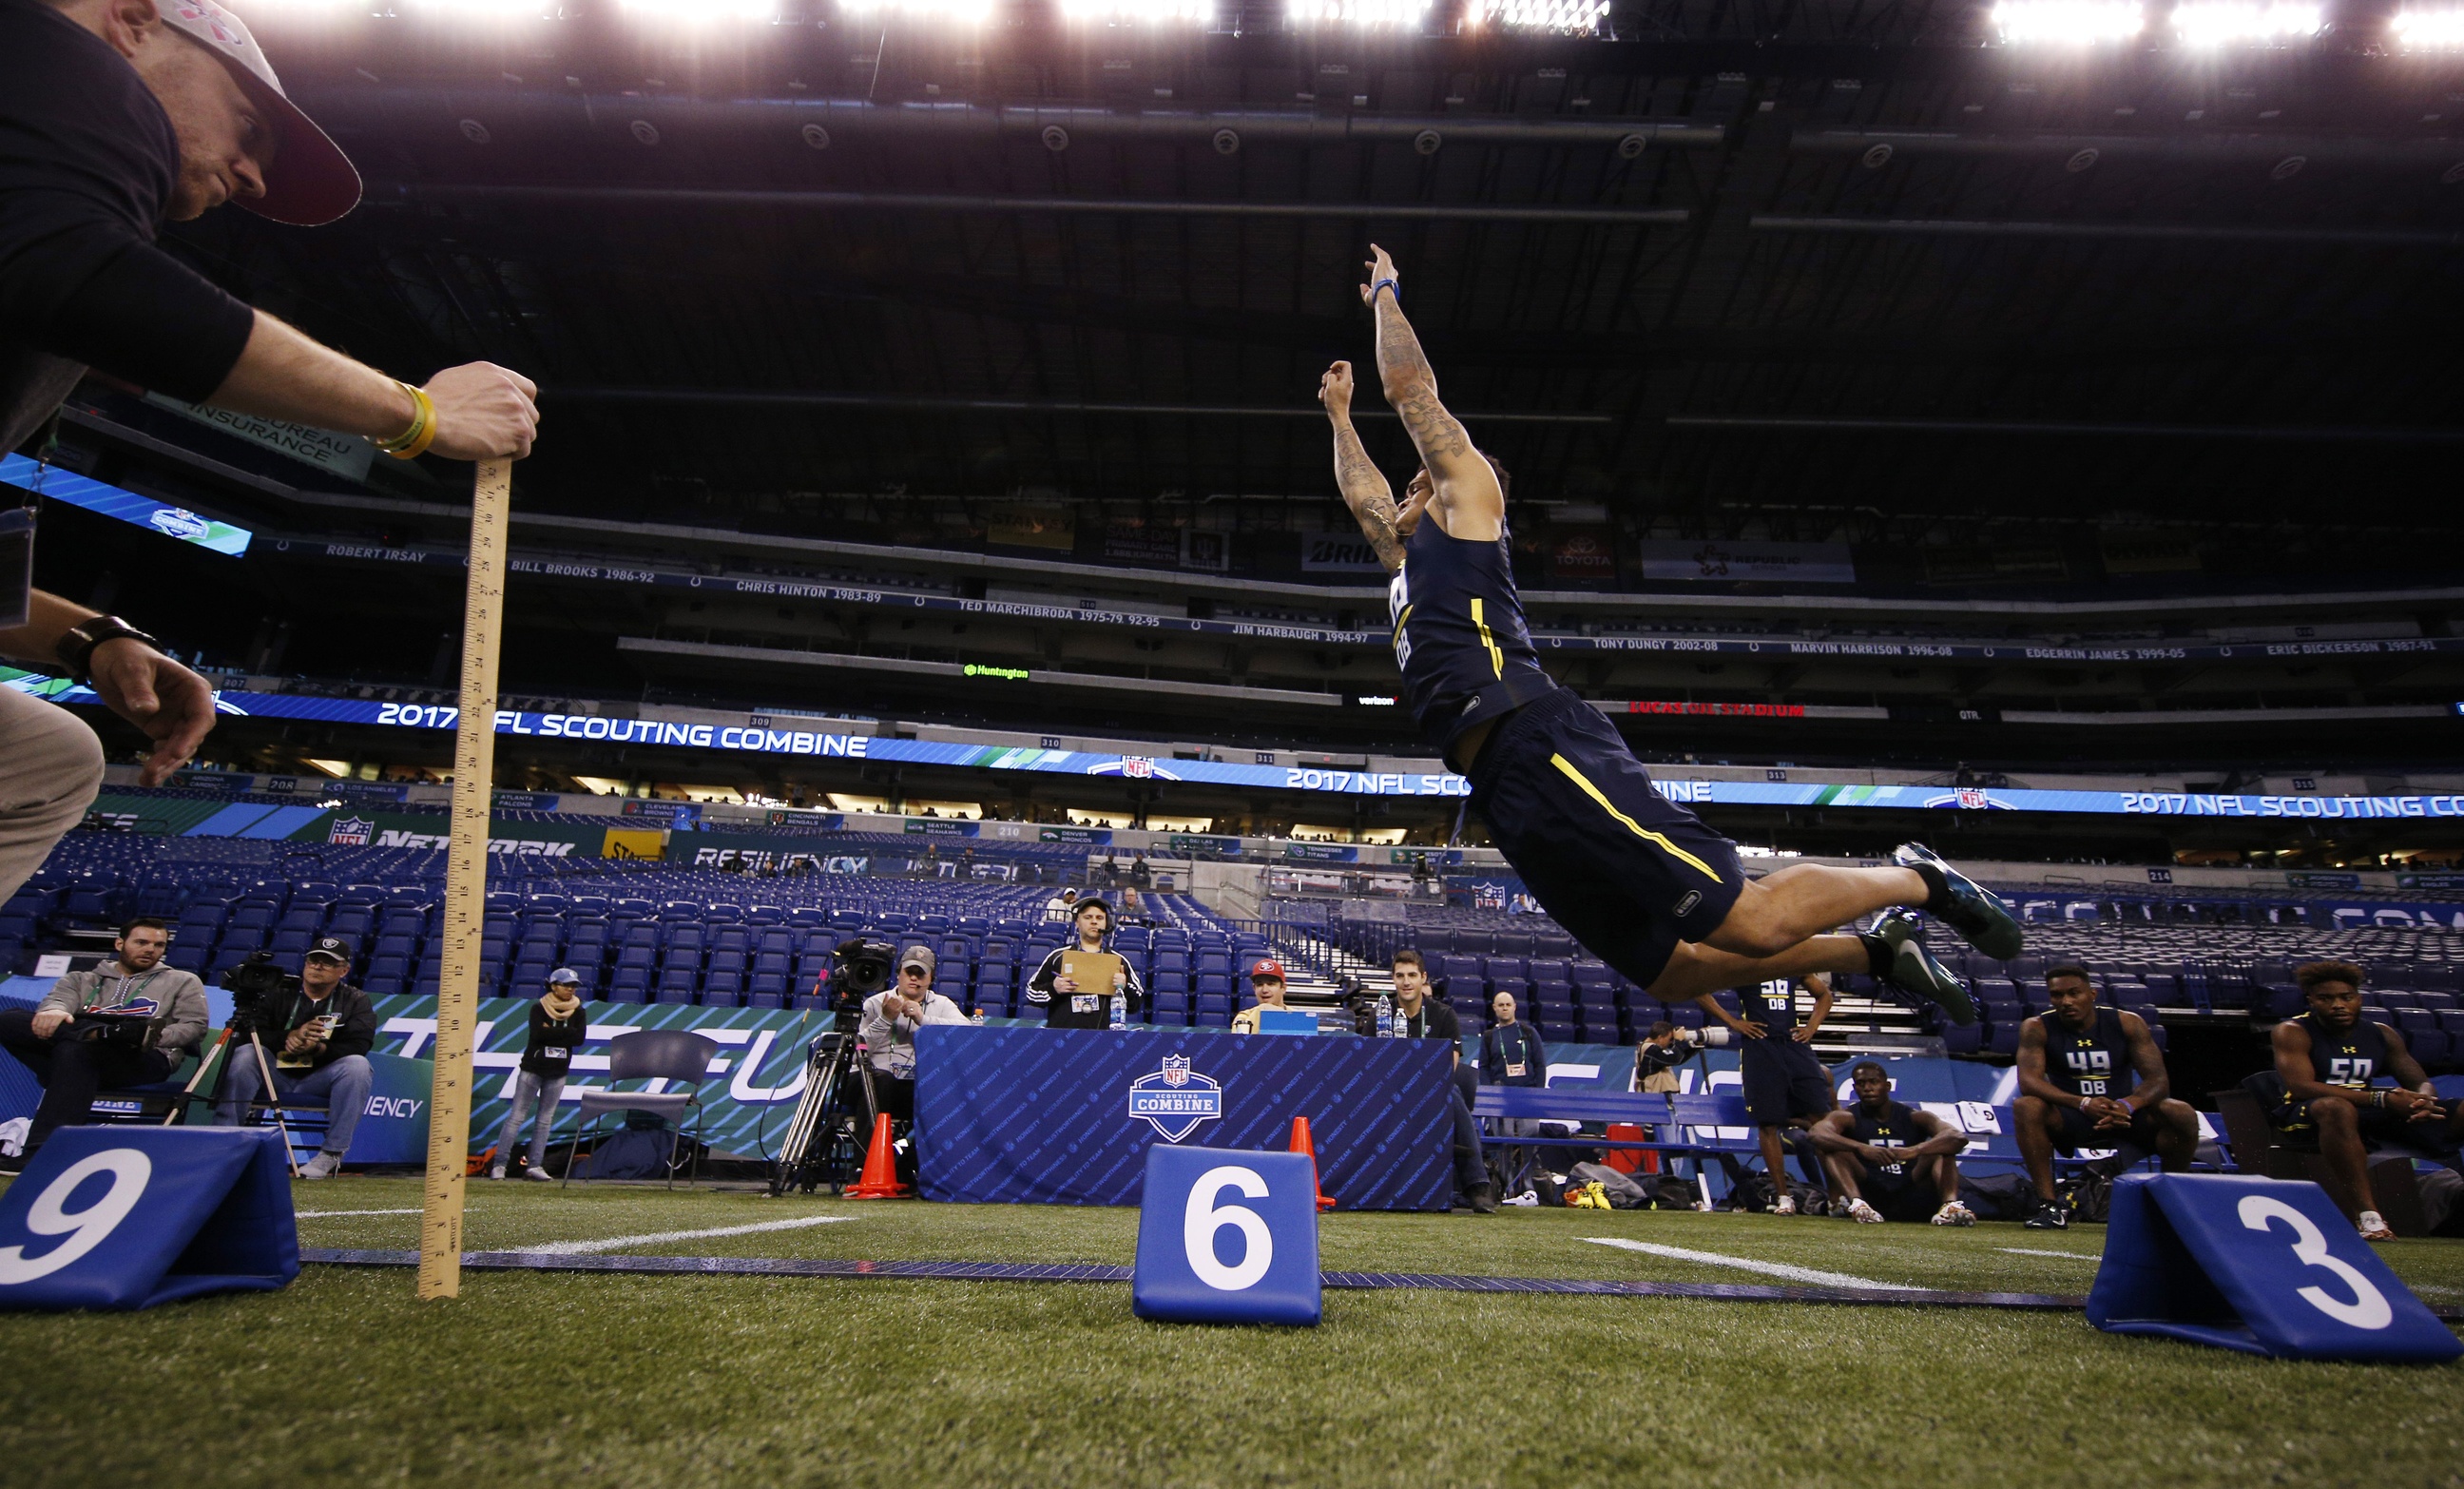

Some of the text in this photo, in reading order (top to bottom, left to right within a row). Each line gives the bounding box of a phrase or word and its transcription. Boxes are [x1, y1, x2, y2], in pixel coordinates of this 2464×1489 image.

[189, 406, 333, 462] INSURANCE
[489, 467, 496, 478] 32
[487, 491, 494, 501] 31
[155, 515, 204, 535] COMBINE
[485, 513, 493, 526] 30
[484, 536, 491, 549] 29
[326, 544, 427, 563] ROBERT IRSAY
[1735, 555, 1801, 566] REPUBLIC
[482, 561, 490, 571] 28
[1554, 555, 1611, 567] TOYOTA
[511, 560, 656, 585] BILL BROOKS 1986-92
[480, 584, 488, 596] 27
[736, 580, 882, 604] CHRIS HINTON 1983-89
[478, 609, 487, 619] 26
[959, 600, 983, 612] TED
[985, 603, 1073, 620] MARCHIBRODA
[1128, 614, 1161, 628] 92-95
[477, 632, 485, 644] 25
[1232, 624, 1369, 644] JIM HARBAUGH 1994-97
[1593, 638, 1719, 652] TONY DUNGY 2002-08
[1791, 642, 1954, 657] MARVIN HARRISON 1996-08
[2267, 644, 2295, 656] ERIC
[2297, 642, 2380, 655] DICKERSON
[2026, 648, 2185, 661] EDGERRIN JAMES 1999-05
[475, 658, 483, 668] 24
[977, 665, 1030, 681] Huntington
[224, 678, 245, 687] 307
[474, 682, 482, 693] 23
[1358, 696, 1395, 706] verizon
[472, 706, 480, 718] 22
[1629, 700, 1684, 715] LUCAS
[1721, 702, 1804, 718] STADIUM
[751, 717, 770, 727] 309
[376, 703, 870, 758] 2017 FL SCOUTING COMBINE
[471, 732, 478, 743] 21
[1042, 739, 1060, 748] 310
[469, 757, 477, 768] 20
[1257, 754, 1275, 764] 311
[1126, 761, 1150, 776] NFL
[1286, 768, 1352, 792] 2017
[1357, 774, 1415, 795] NFL
[1768, 771, 1786, 781] 313
[270, 780, 294, 790] 208
[467, 783, 475, 793] 19
[1961, 790, 1985, 806] NFL
[645, 803, 685, 812] CLEVELAND
[2120, 792, 2187, 814] 2017
[2193, 795, 2257, 816] NFL
[2260, 796, 2427, 819] SCOUTING
[465, 808, 473, 819] 18
[464, 833, 472, 844] 17
[999, 827, 1020, 837] 210
[462, 860, 470, 870] 16
[2150, 870, 2171, 881] 214
[460, 885, 469, 897] 15
[459, 912, 467, 923] 14
[457, 938, 465, 949] 13
[455, 965, 463, 977] 12
[453, 994, 461, 1003] 11
[1768, 997, 1786, 1011] DB
[452, 1019, 459, 1031] 10
[943, 1030, 983, 1067] ACCOUNTABILITY
[1065, 1033, 1103, 1069] ACCOUNTABILITY
[1024, 1048, 1054, 1077] LEADERSHIP
[1325, 1051, 1353, 1080] LEADERSHIP
[2066, 1050, 2110, 1076] 49
[1166, 1069, 1186, 1084] NFL
[2326, 1057, 2373, 1086] 50
[977, 1068, 1002, 1091] HONESTY
[1099, 1070, 1123, 1093] HONESTY
[1342, 1071, 1363, 1093] HONESTY
[2080, 1079, 2106, 1096] DB
[1137, 1098, 1214, 1114] COMBINE
[1227, 1081, 1264, 1119] ACCOUNTABILITY
[1408, 1081, 1442, 1118] ACCOUNTABILITY
[954, 1118, 979, 1142] HONESTY
[982, 1102, 1028, 1145] TRUSTWORTHINESS
[1352, 1104, 1393, 1147] TRUSTWORTHINESS
[1263, 1121, 1286, 1146] HONESTY
[1084, 1154, 1129, 1197] TRUSTWORTHINESS
[1334, 1154, 1376, 1198] TRUSTWORTHINESS
[0, 1148, 152, 1286] 9
[1184, 1166, 1273, 1291] 6
[2238, 1195, 2393, 1330] 3
